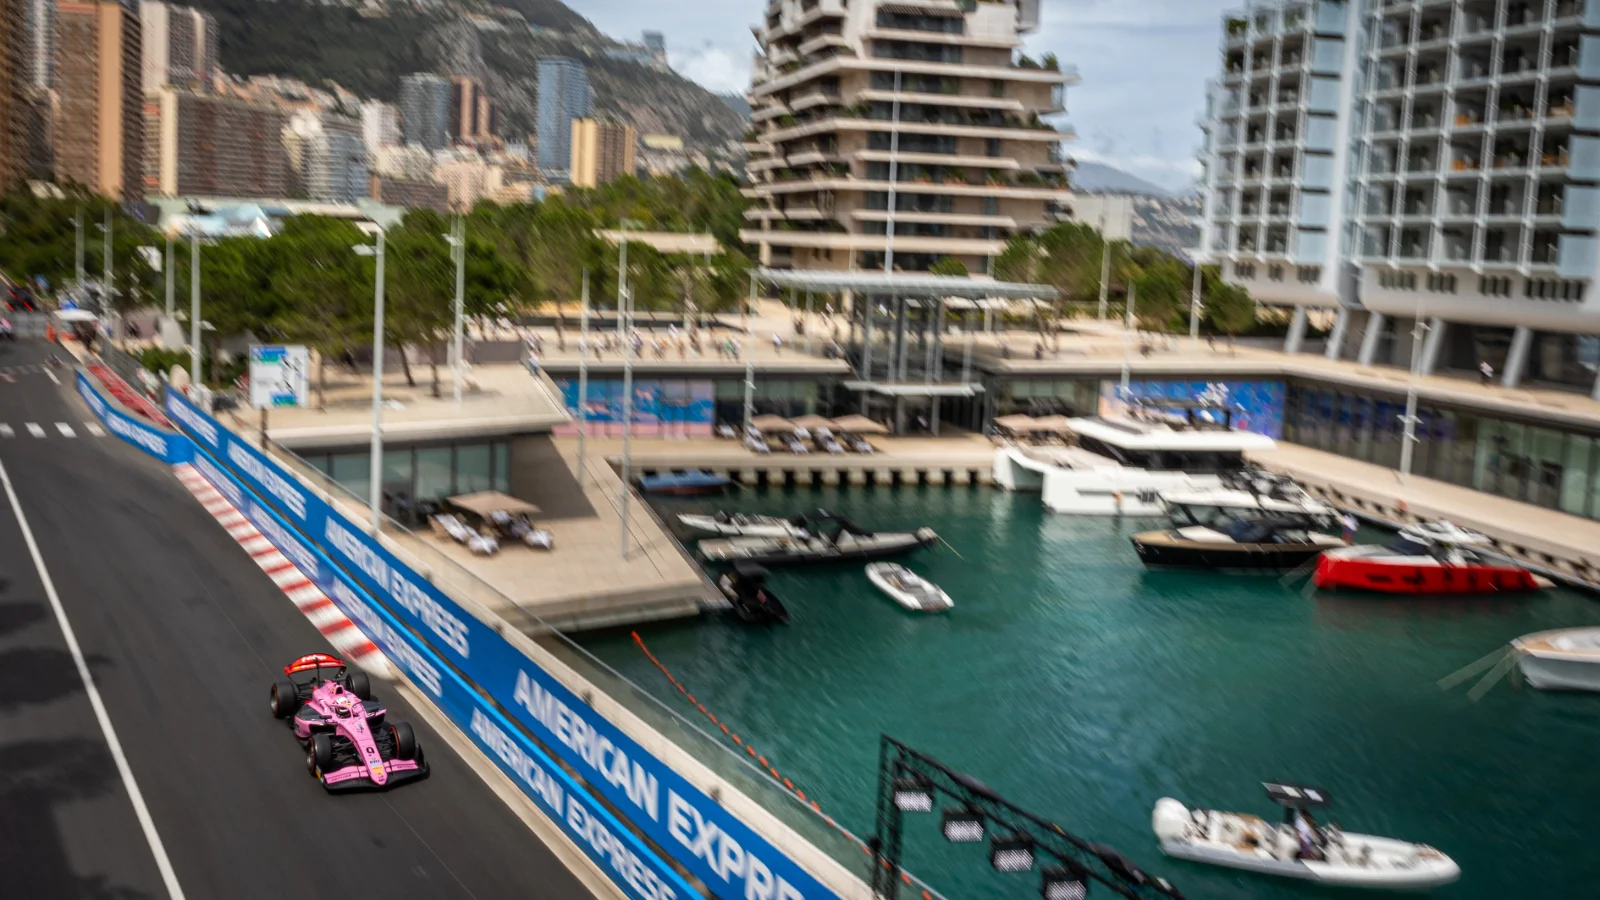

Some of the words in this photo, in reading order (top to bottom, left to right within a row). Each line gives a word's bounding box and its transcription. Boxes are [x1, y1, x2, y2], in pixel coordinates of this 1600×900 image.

[391, 567, 469, 659] EXPRESS
[470, 707, 563, 818] AMERICAN
[514, 669, 658, 822] AMERICAN
